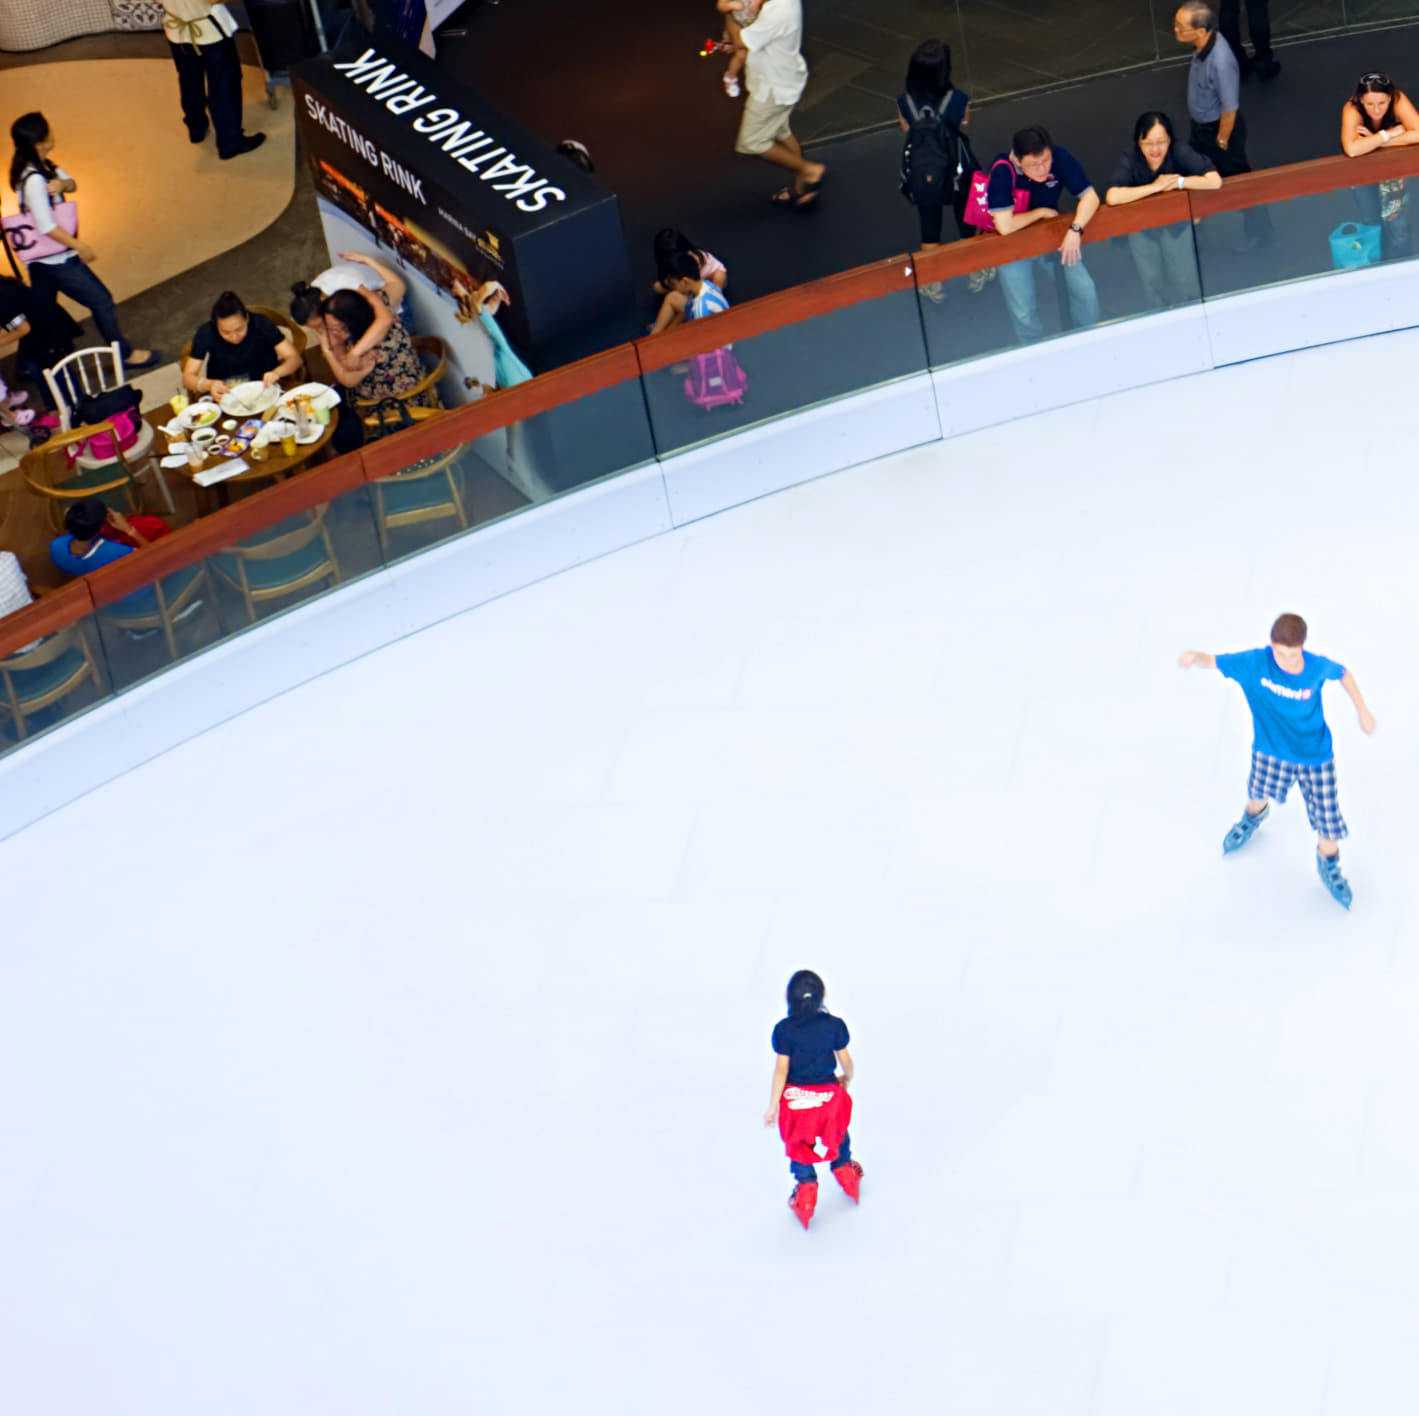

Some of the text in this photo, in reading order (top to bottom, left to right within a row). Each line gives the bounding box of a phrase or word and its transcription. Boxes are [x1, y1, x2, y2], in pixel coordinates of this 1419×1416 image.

[304, 94, 426, 205] SKATING RINK
[333, 48, 566, 212] SKATING RINK
